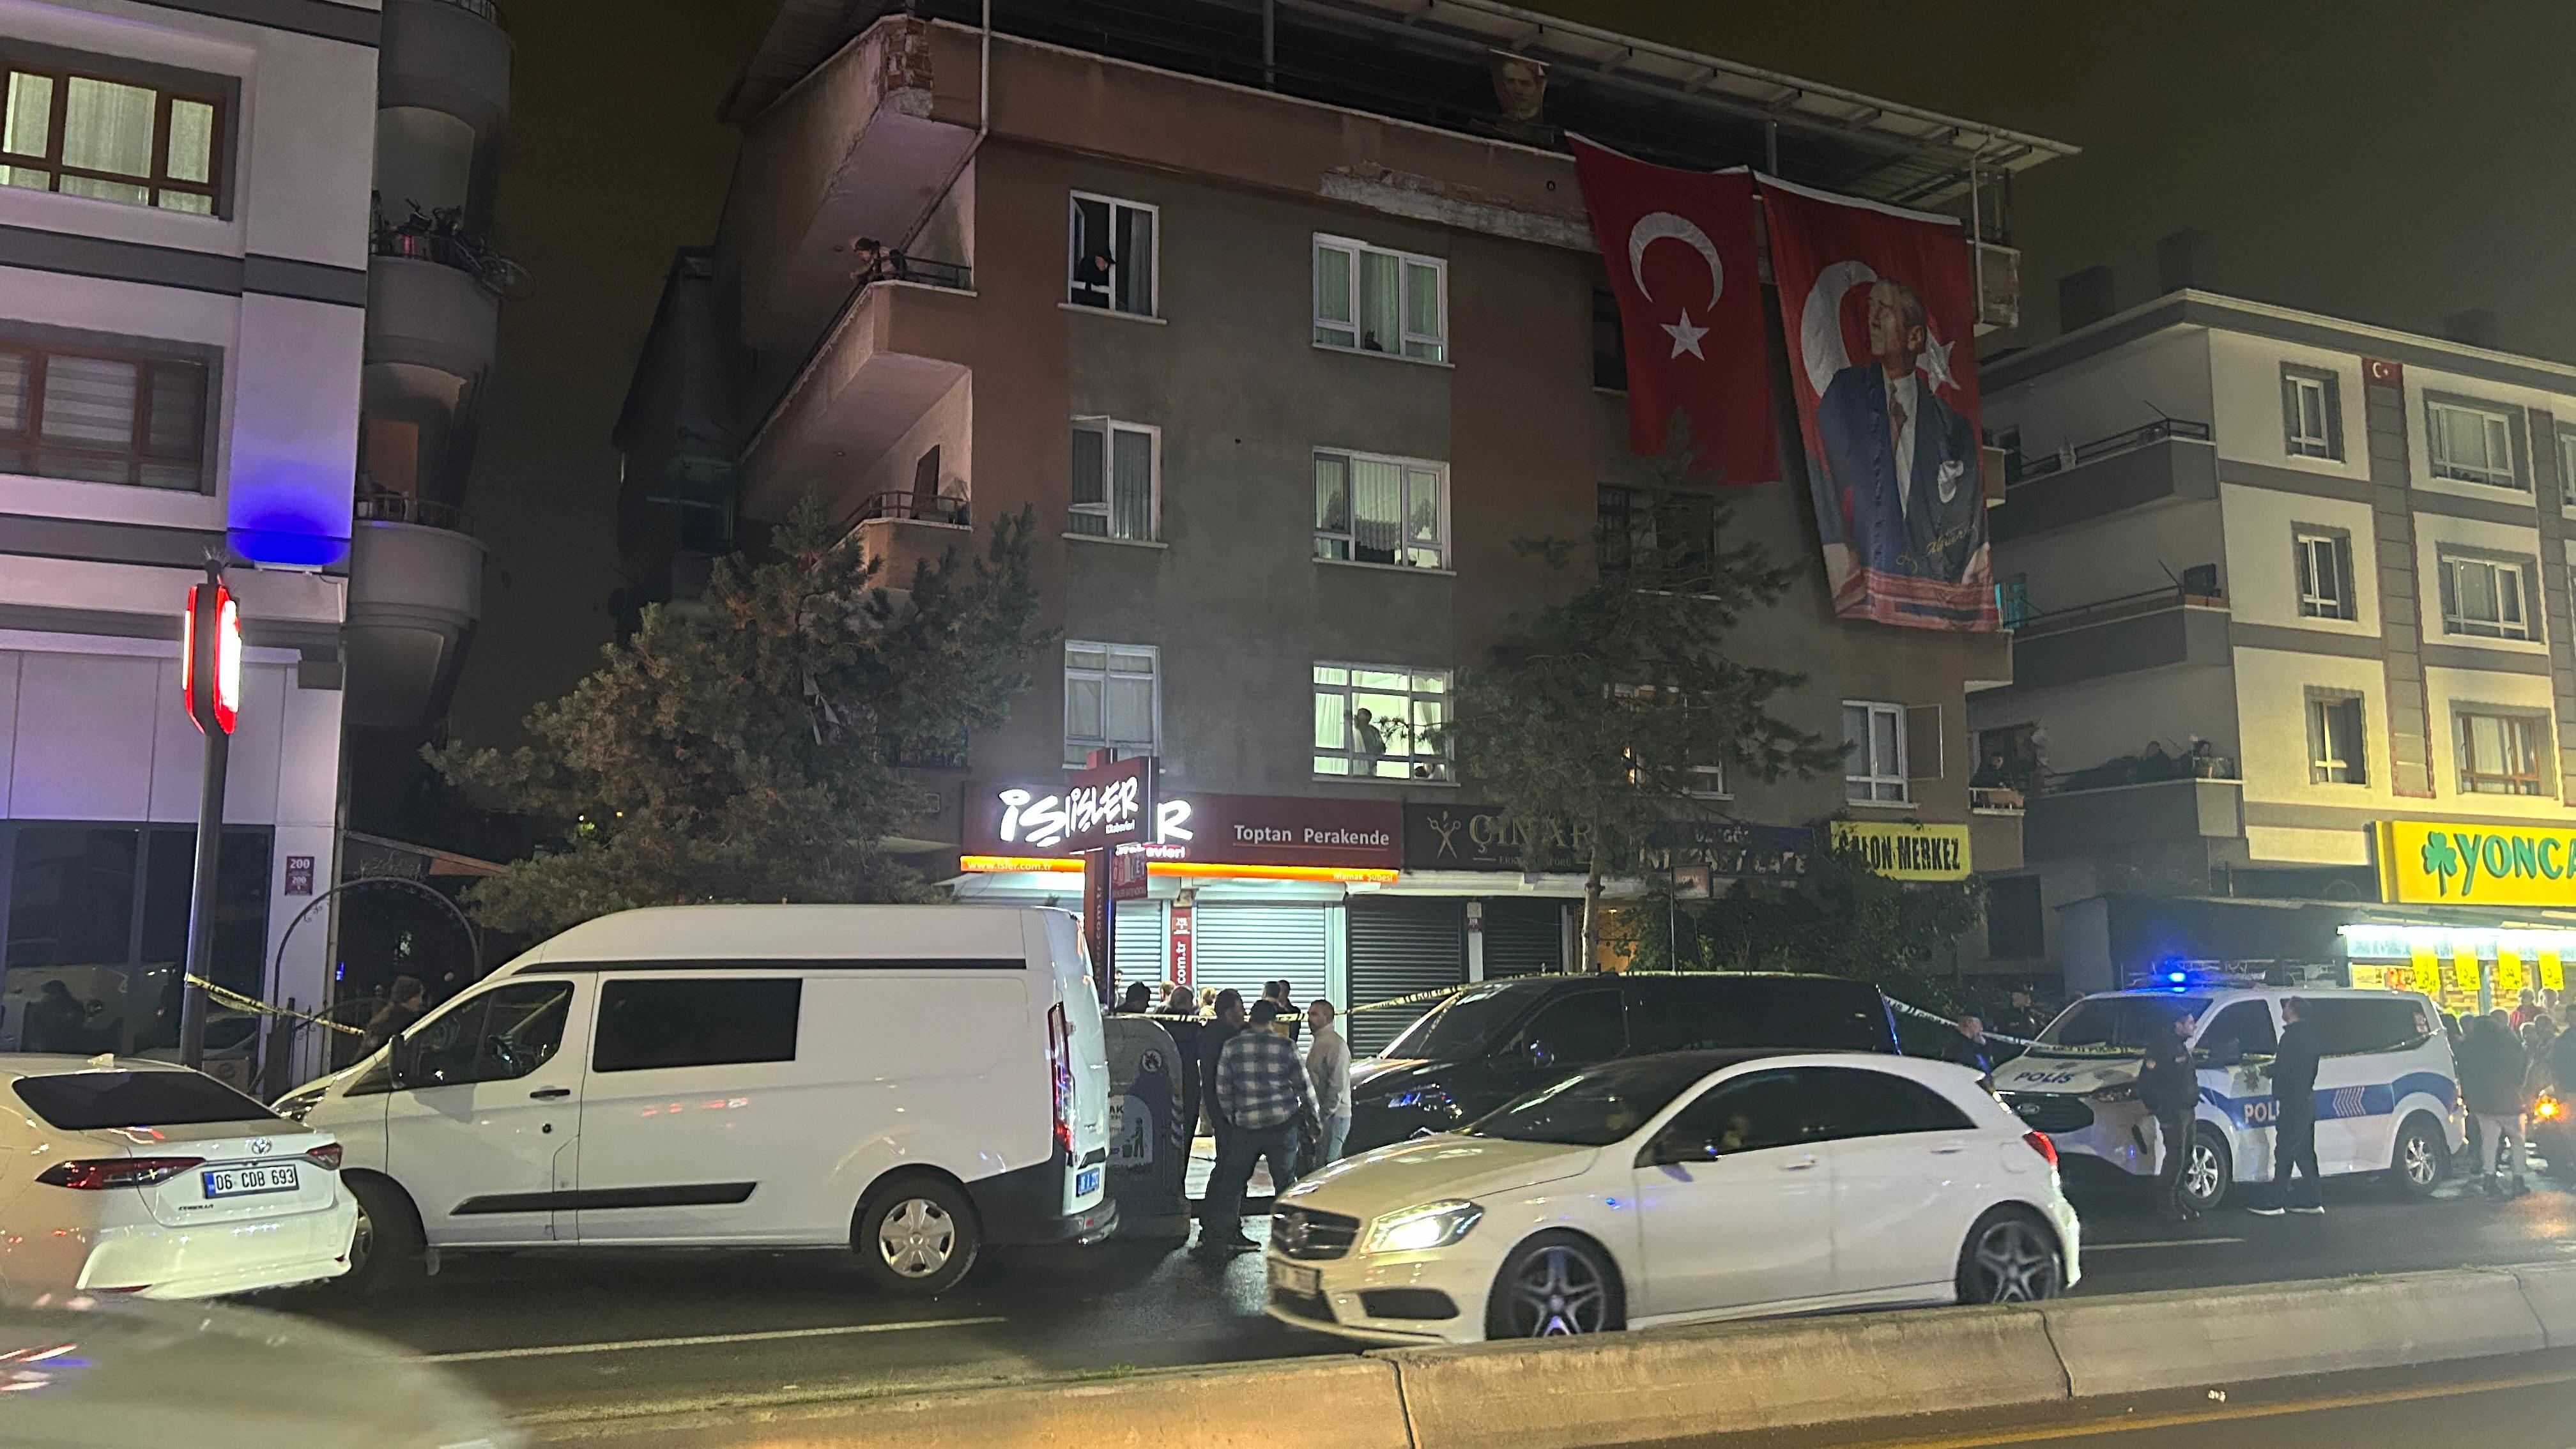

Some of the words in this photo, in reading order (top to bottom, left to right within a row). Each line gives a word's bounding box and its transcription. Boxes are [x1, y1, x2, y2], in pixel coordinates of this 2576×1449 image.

[1234, 825, 1292, 844] Toptan
[1304, 828, 1390, 846] Perakende
[290, 859, 310, 869] 200
[1897, 836, 1961, 871] MERKEZ
[2013, 1071, 2075, 1084] POLİS
[215, 1174, 233, 1191] 06
[241, 1170, 265, 1188] CDB
[272, 1169, 295, 1185] 693
